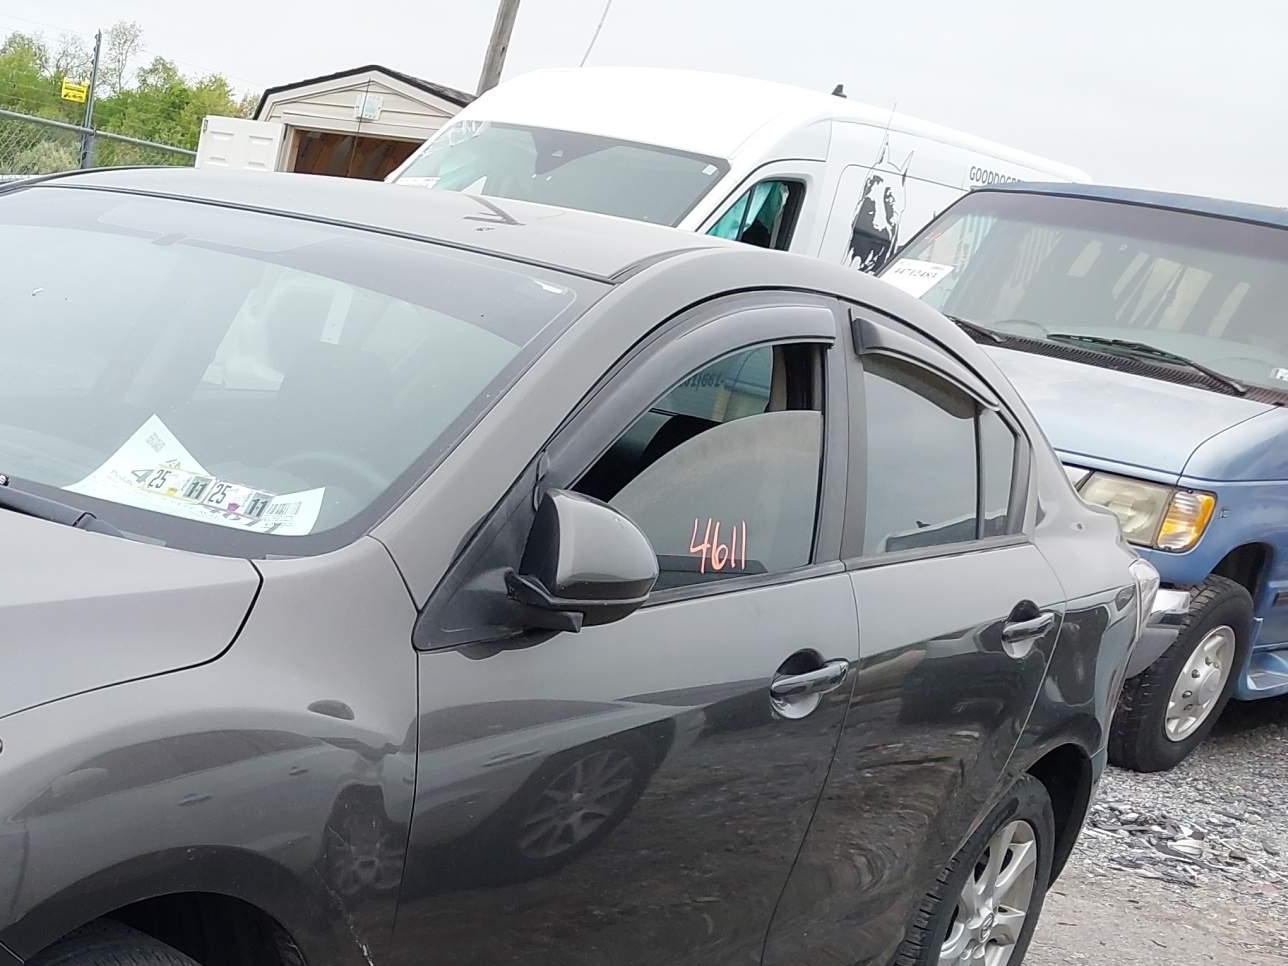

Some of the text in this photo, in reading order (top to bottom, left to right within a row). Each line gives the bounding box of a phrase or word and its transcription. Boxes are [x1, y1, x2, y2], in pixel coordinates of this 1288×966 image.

[148, 469, 208, 499] 25 11
[207, 483, 268, 517] 25 11
[690, 517, 746, 575] 4611
